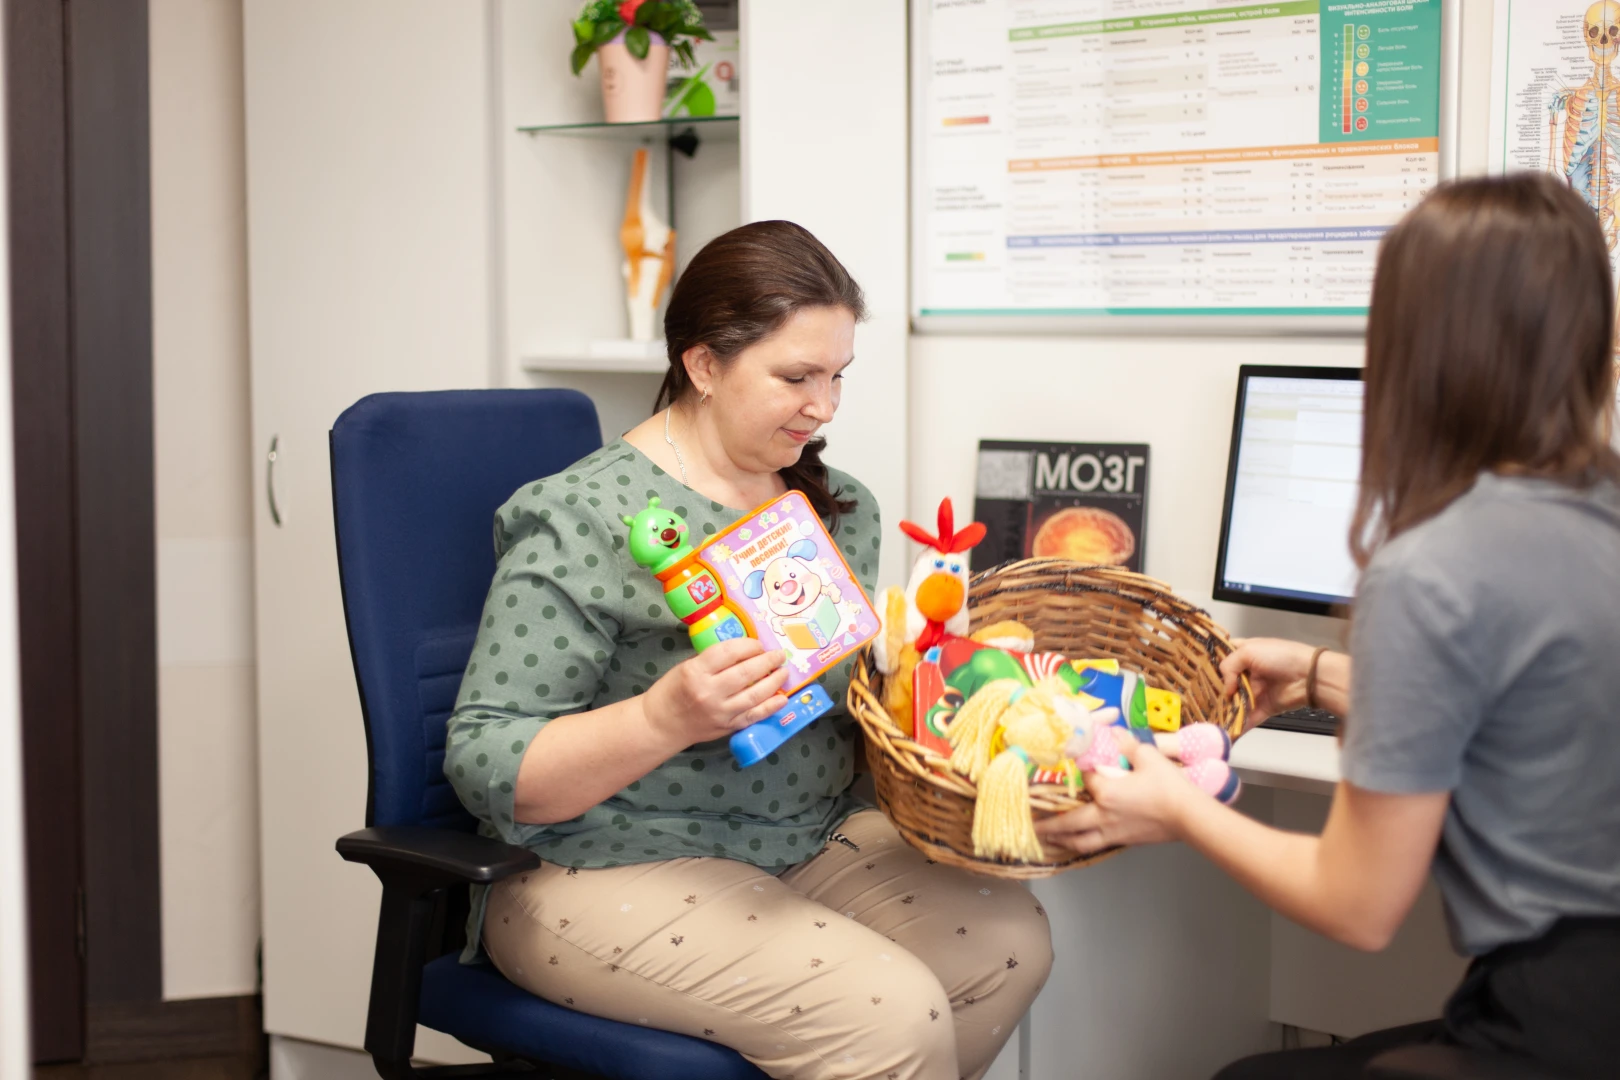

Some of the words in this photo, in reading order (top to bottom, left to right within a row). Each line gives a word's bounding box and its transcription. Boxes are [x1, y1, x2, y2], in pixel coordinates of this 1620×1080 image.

[1328, 0, 1406, 12] ВИЗУАЛЬНО-АНАЛОГОВАЯ
[1344, 6, 1395, 16] ИНТЕНСИВНОСТИ
[1035, 453, 1145, 493] МОЗГ
[733, 545, 756, 564] Учим
[757, 522, 793, 548] детские
[750, 538, 788, 568] песенки!
[693, 581, 716, 601] 123
